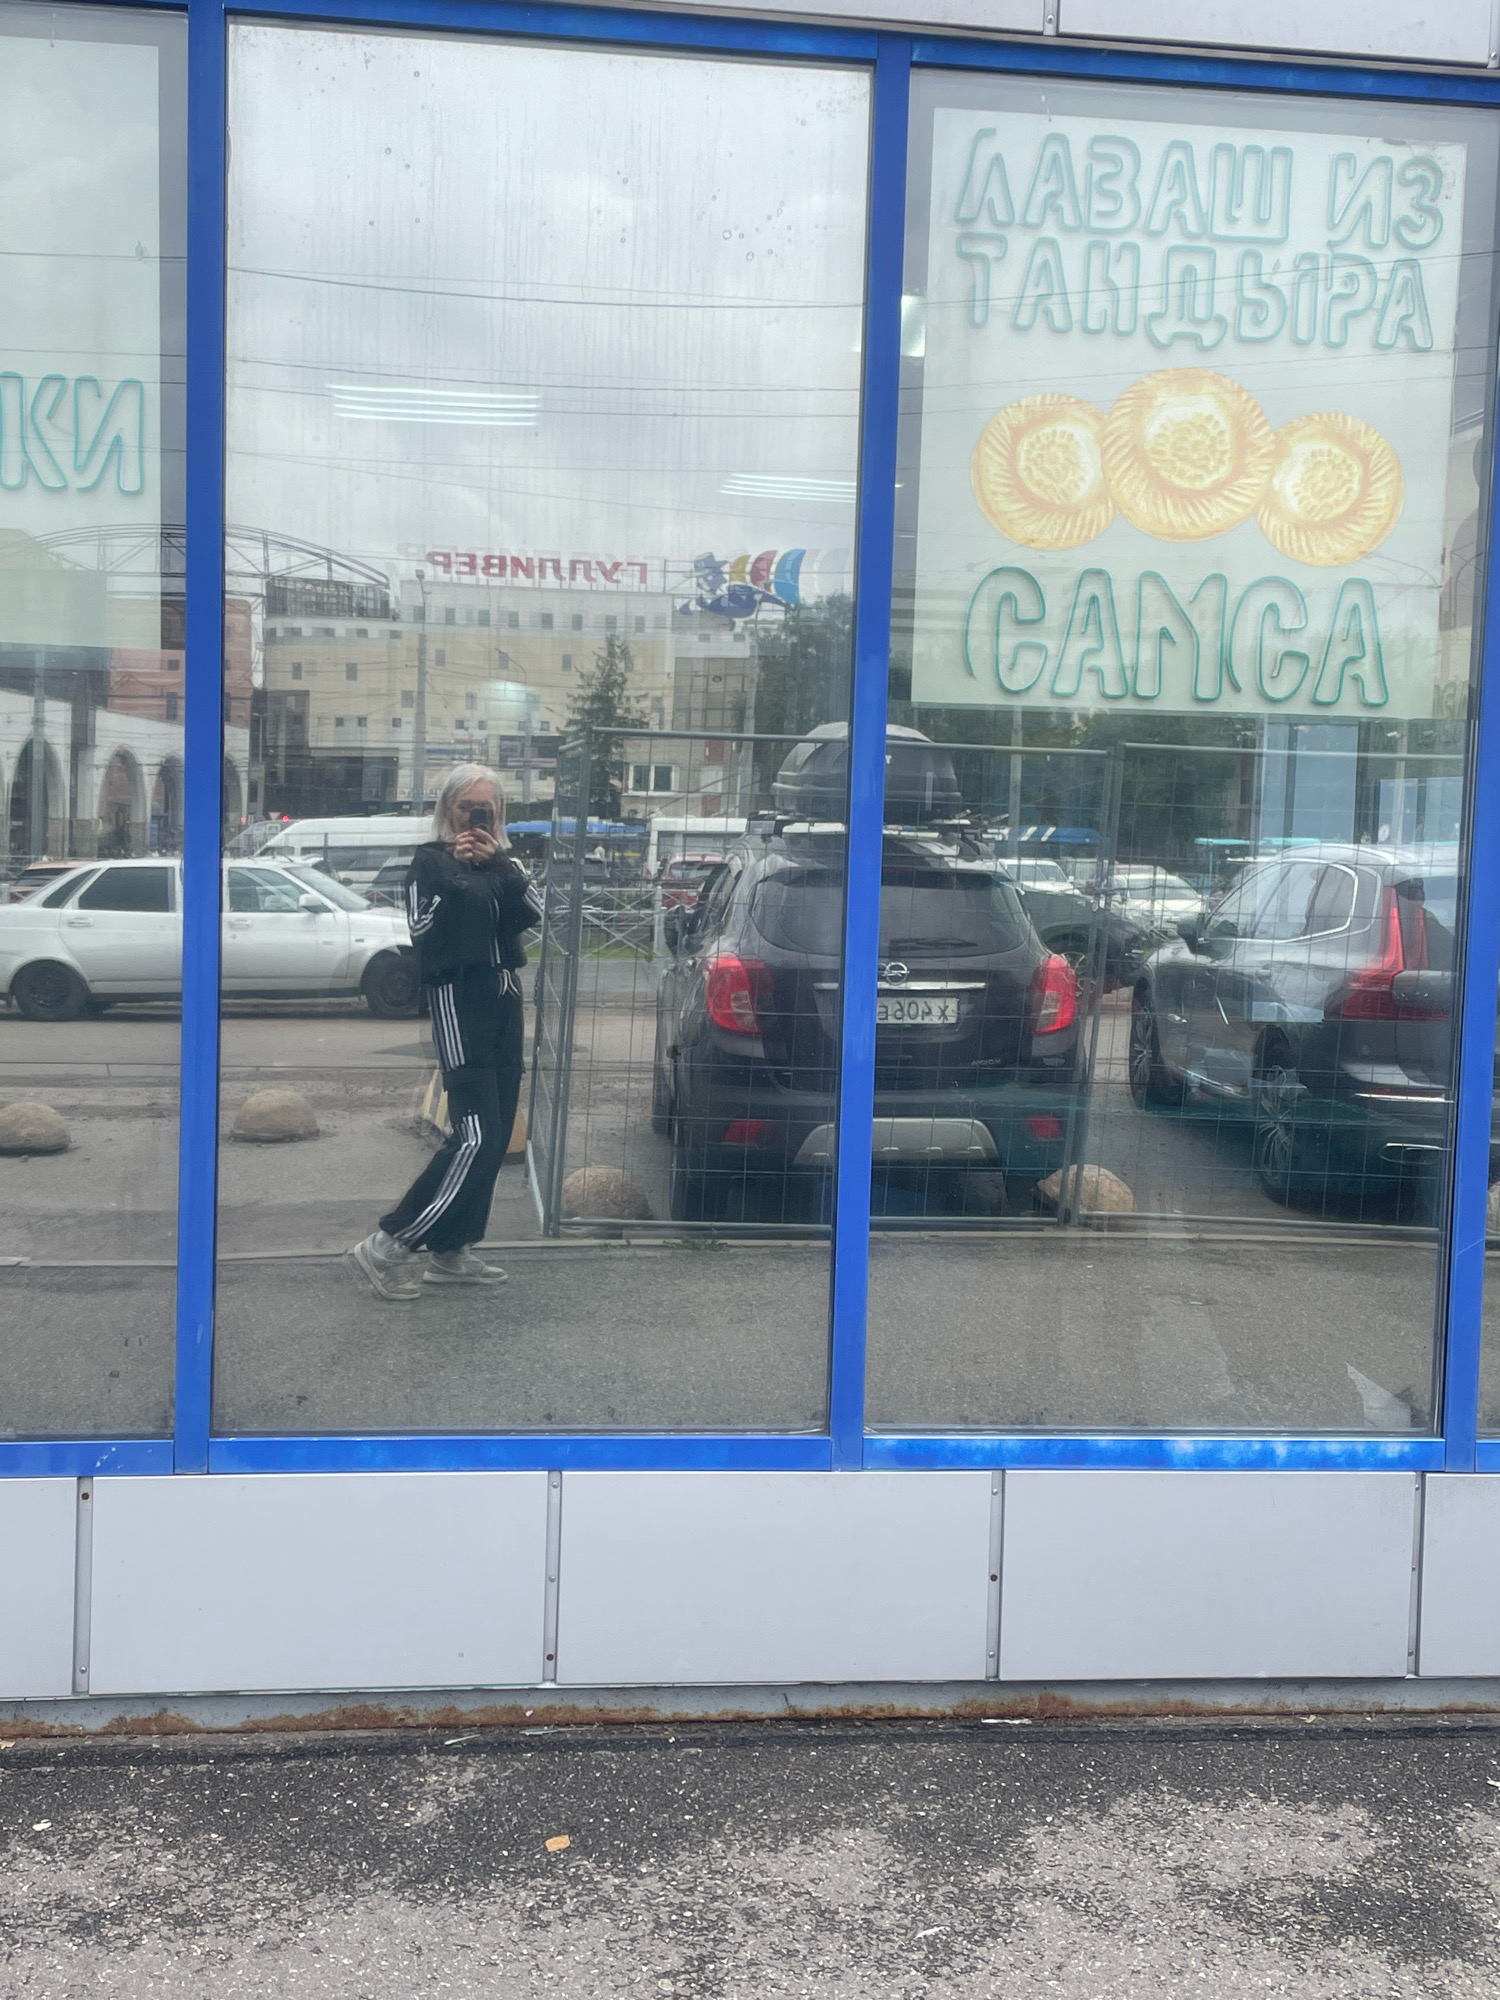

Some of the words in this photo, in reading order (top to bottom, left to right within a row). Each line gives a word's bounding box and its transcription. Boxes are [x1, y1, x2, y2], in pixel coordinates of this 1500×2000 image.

[954, 127, 1294, 245] ЛАВАШ
[1326, 151, 1444, 250] ИЗ
[956, 231, 1434, 351] ТАНДЫРА
[964, 565, 1389, 707] САМСА
